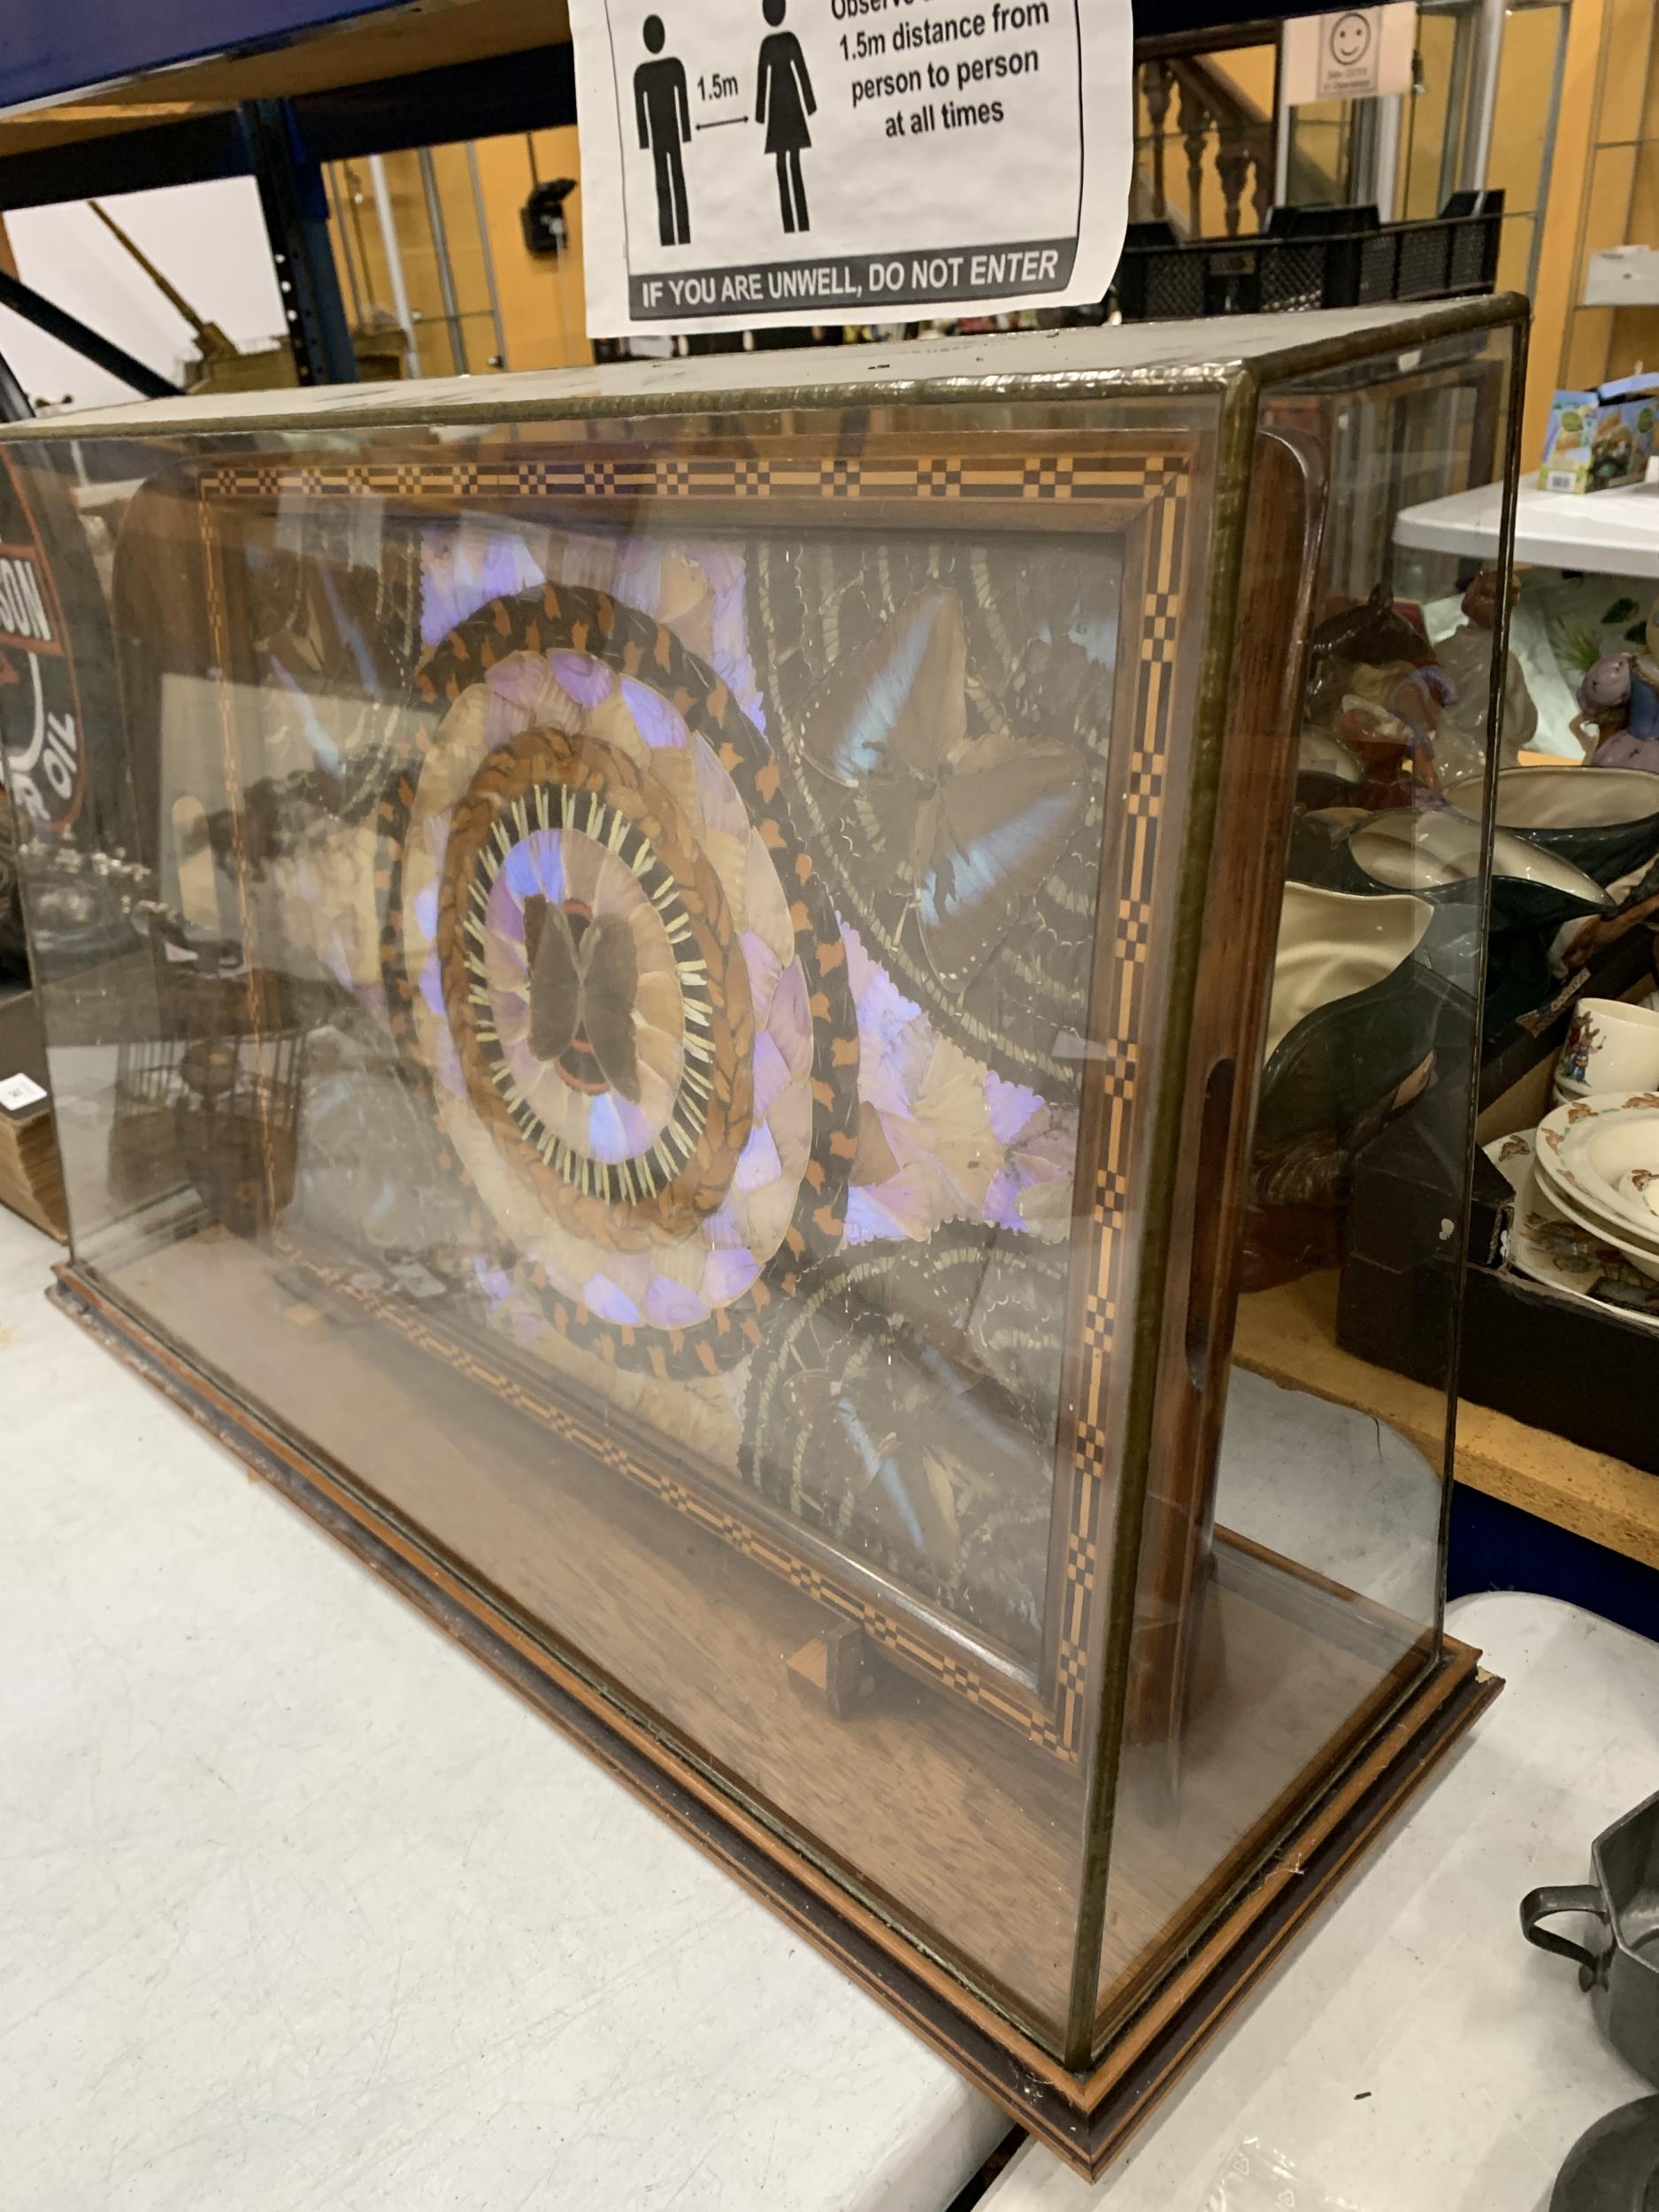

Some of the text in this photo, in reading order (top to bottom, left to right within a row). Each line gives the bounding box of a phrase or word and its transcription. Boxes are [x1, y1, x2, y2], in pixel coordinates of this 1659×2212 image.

[840, 2, 1049, 61] 1.5m distance from
[697, 73, 738, 102] 1.5m
[851, 50, 1040, 109] person to person
[885, 100, 1005, 137] at all times
[642, 249, 1060, 308] IF YOU ARE UNWELL, DO NOT ENTER
[42, 712, 77, 800] OIL
